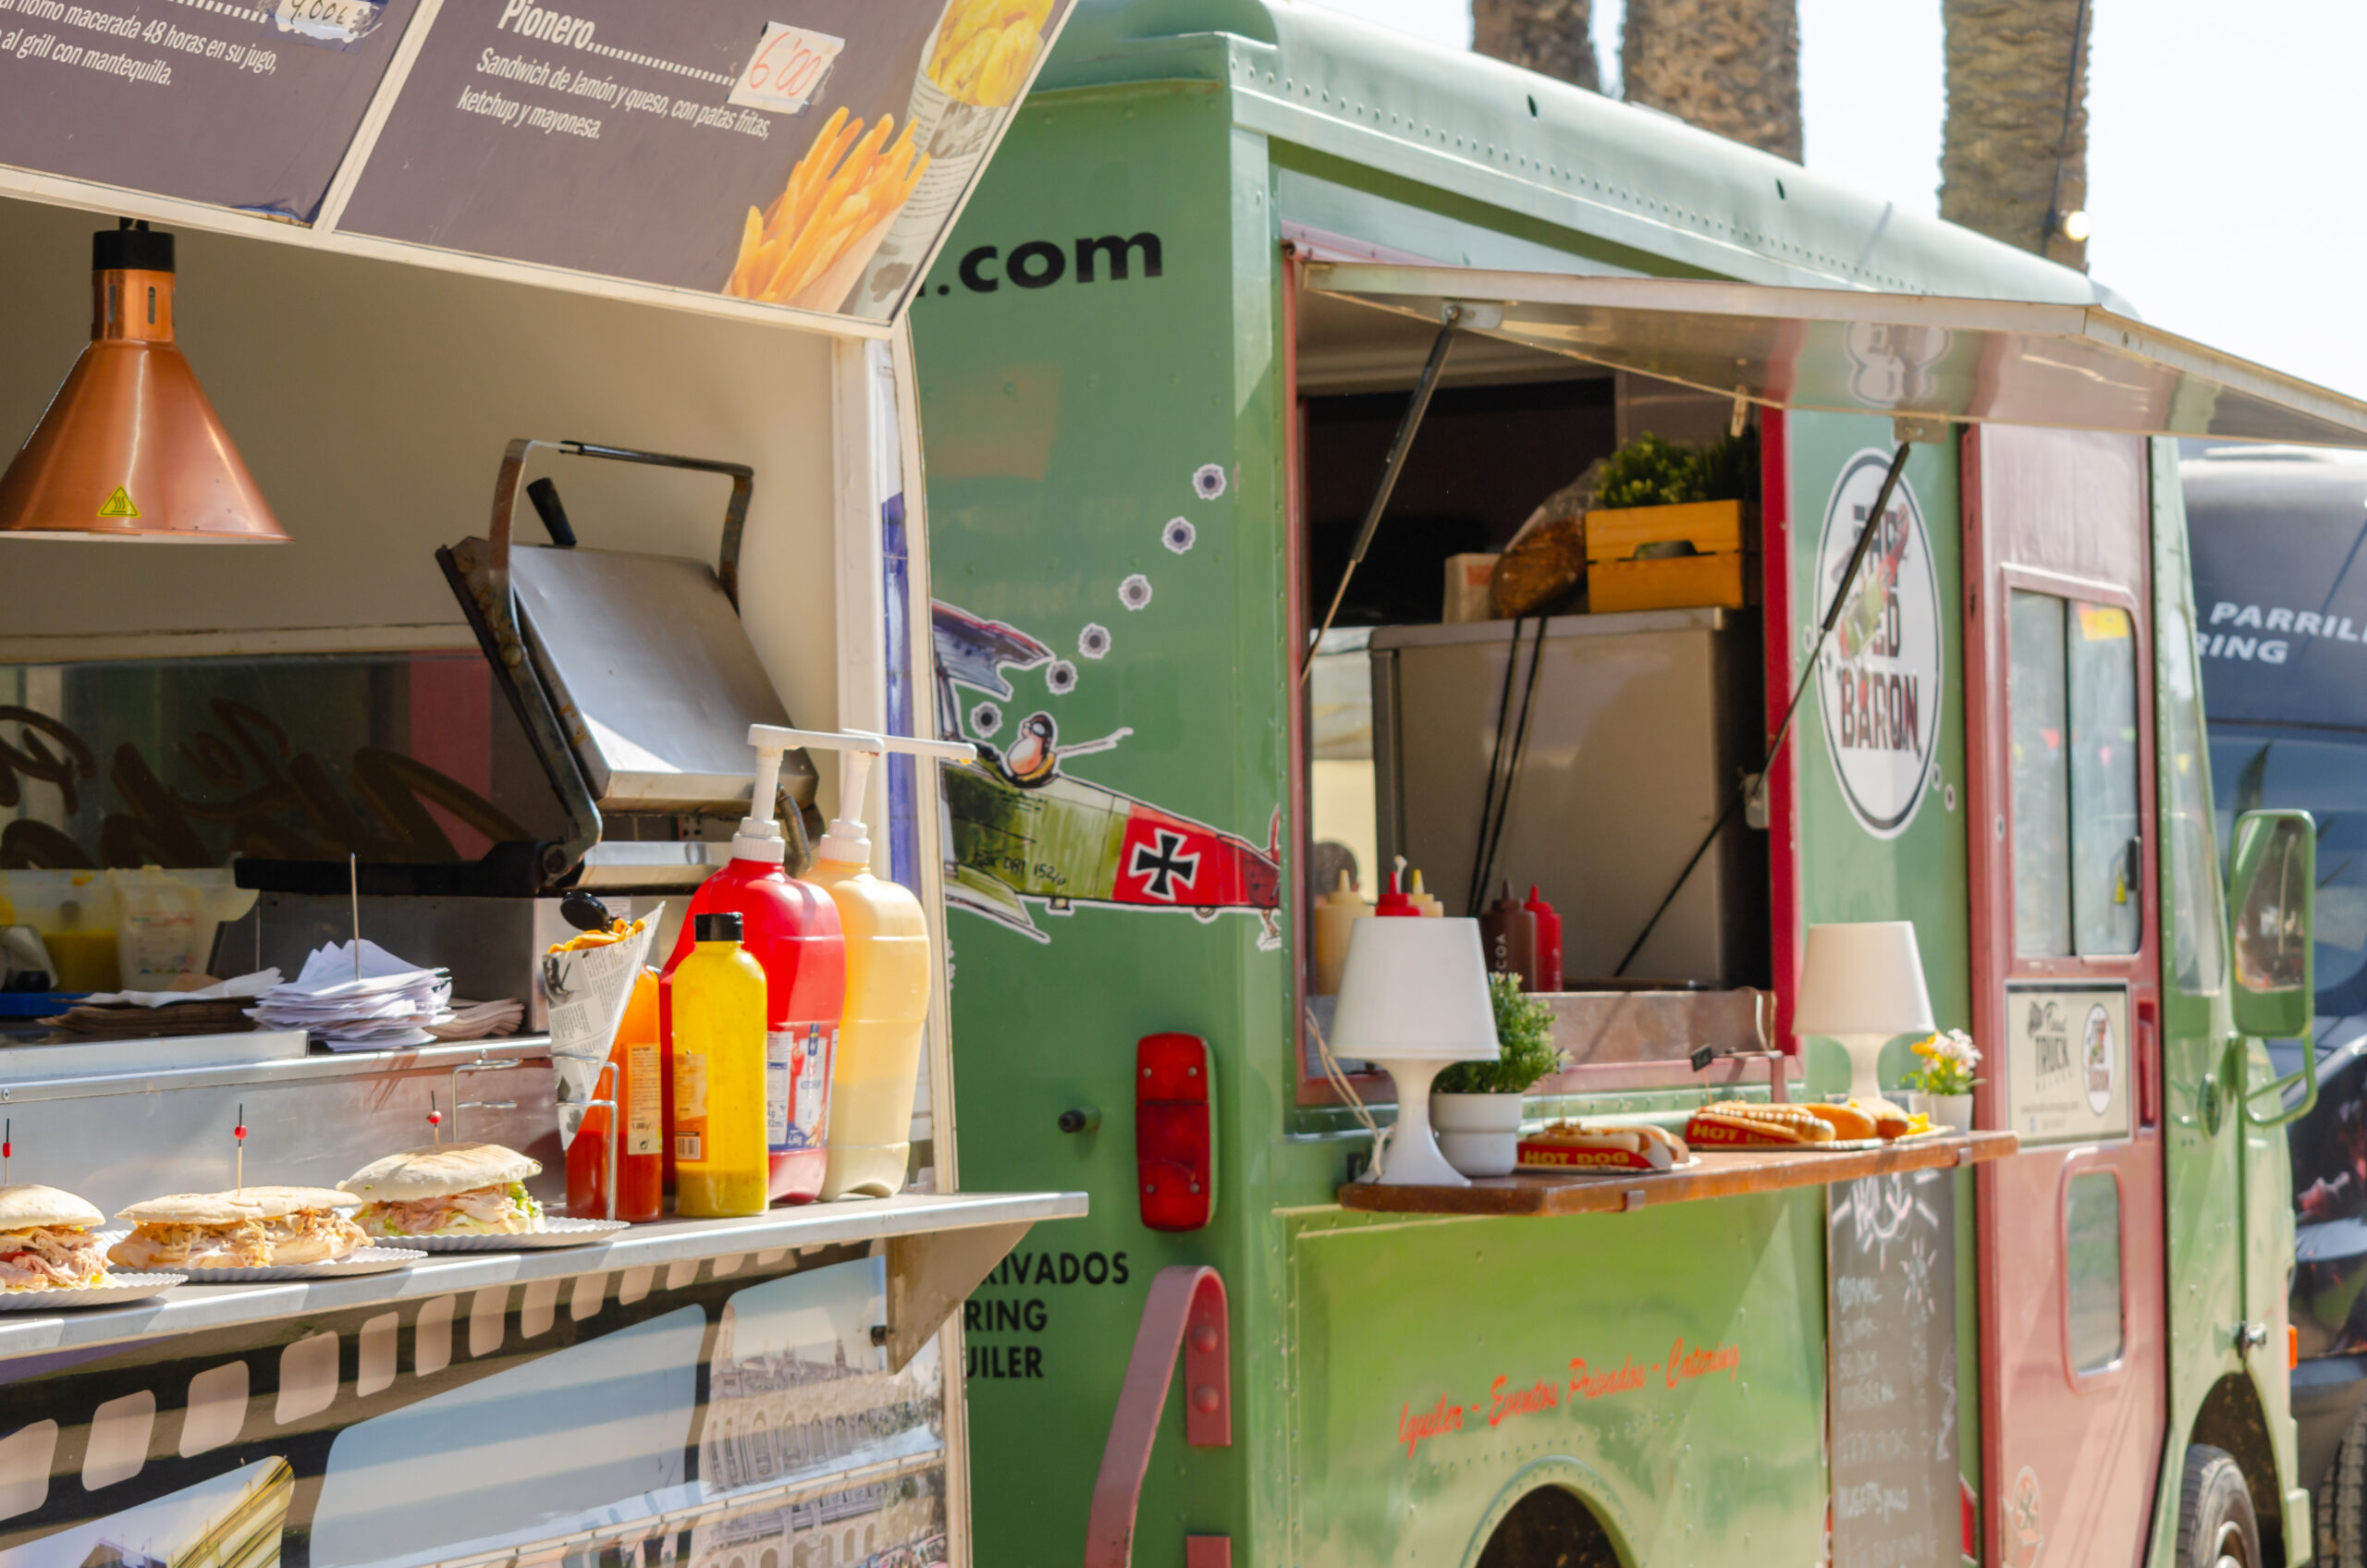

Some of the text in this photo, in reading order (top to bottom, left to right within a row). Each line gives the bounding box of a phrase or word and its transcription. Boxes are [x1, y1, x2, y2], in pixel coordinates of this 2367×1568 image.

[1, 28, 172, 86] al grill con mantequilla.
[63, 6, 141, 39] macerada
[141, 19, 167, 44] 48
[163, 24, 207, 55] horas
[205, 40, 227, 59] en
[225, 43, 246, 64] su
[239, 43, 277, 75] jugo,
[457, 84, 602, 140] ketchup y mayonesa.
[476, 47, 772, 141] Sandwich de Jamón y queso, con patas fritas,
[915, 232, 1162, 298] .com
[1840, 668, 1919, 751] BARON
[1524, 1150, 1630, 1165] HOT DOG
[1690, 1121, 1740, 1142] HOT
[1489, 1374, 1559, 1427] Eventos
[1566, 1353, 1646, 1403] Privados
[1666, 1337, 1740, 1390] Catering
